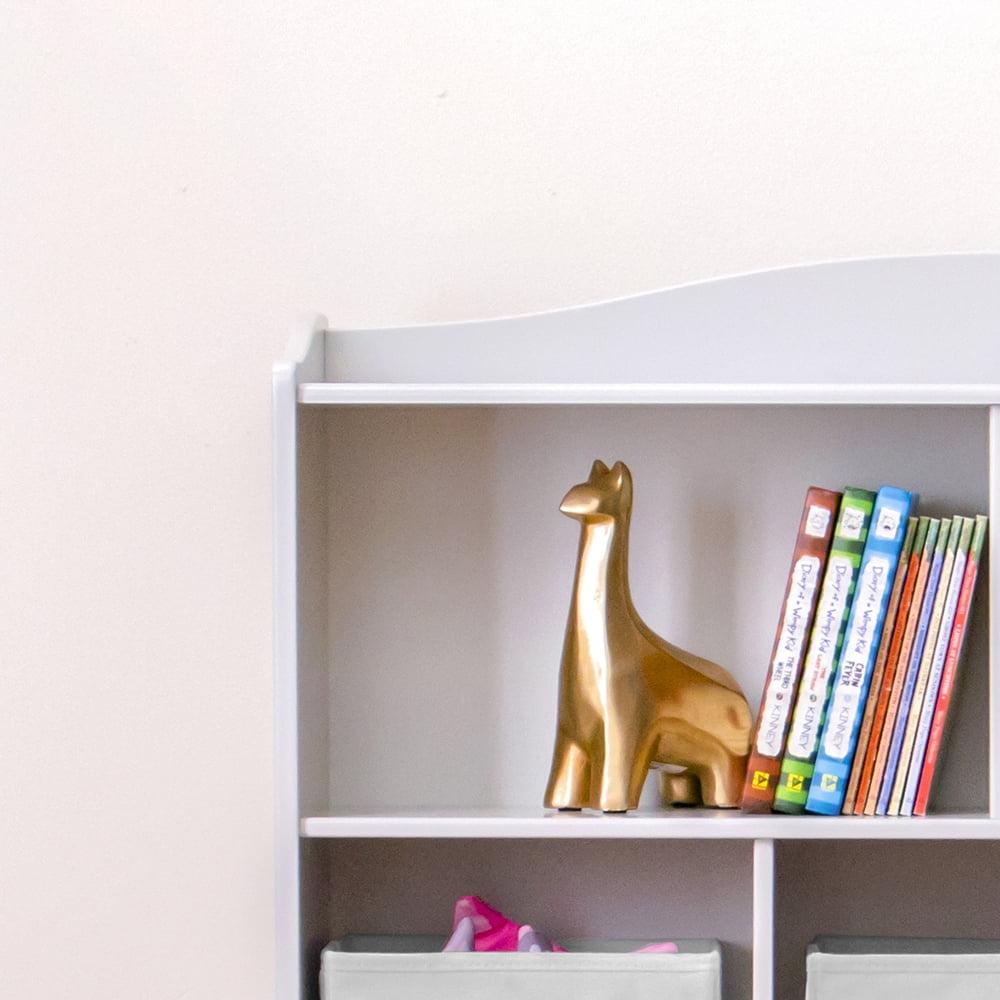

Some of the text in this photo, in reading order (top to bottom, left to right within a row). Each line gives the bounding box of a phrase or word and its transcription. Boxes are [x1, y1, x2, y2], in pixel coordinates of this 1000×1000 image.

[797, 564, 812, 590] Diary
[832, 565, 847, 591] Diary
[868, 566, 883, 592] Diary
[787, 607, 802, 635] Wimpy
[821, 609, 836, 637] Wimpy
[857, 610, 872, 637] Wimpy
[784, 637, 796, 651] Kid
[819, 638, 831, 653] Kid
[855, 639, 867, 653] Kid
[841, 661, 855, 686] FEVER
[851, 662, 864, 687] CABIN
[765, 704, 782, 749] KINNEY
[798, 706, 815, 751] KINNEY
[832, 706, 850, 750] KINNEY
